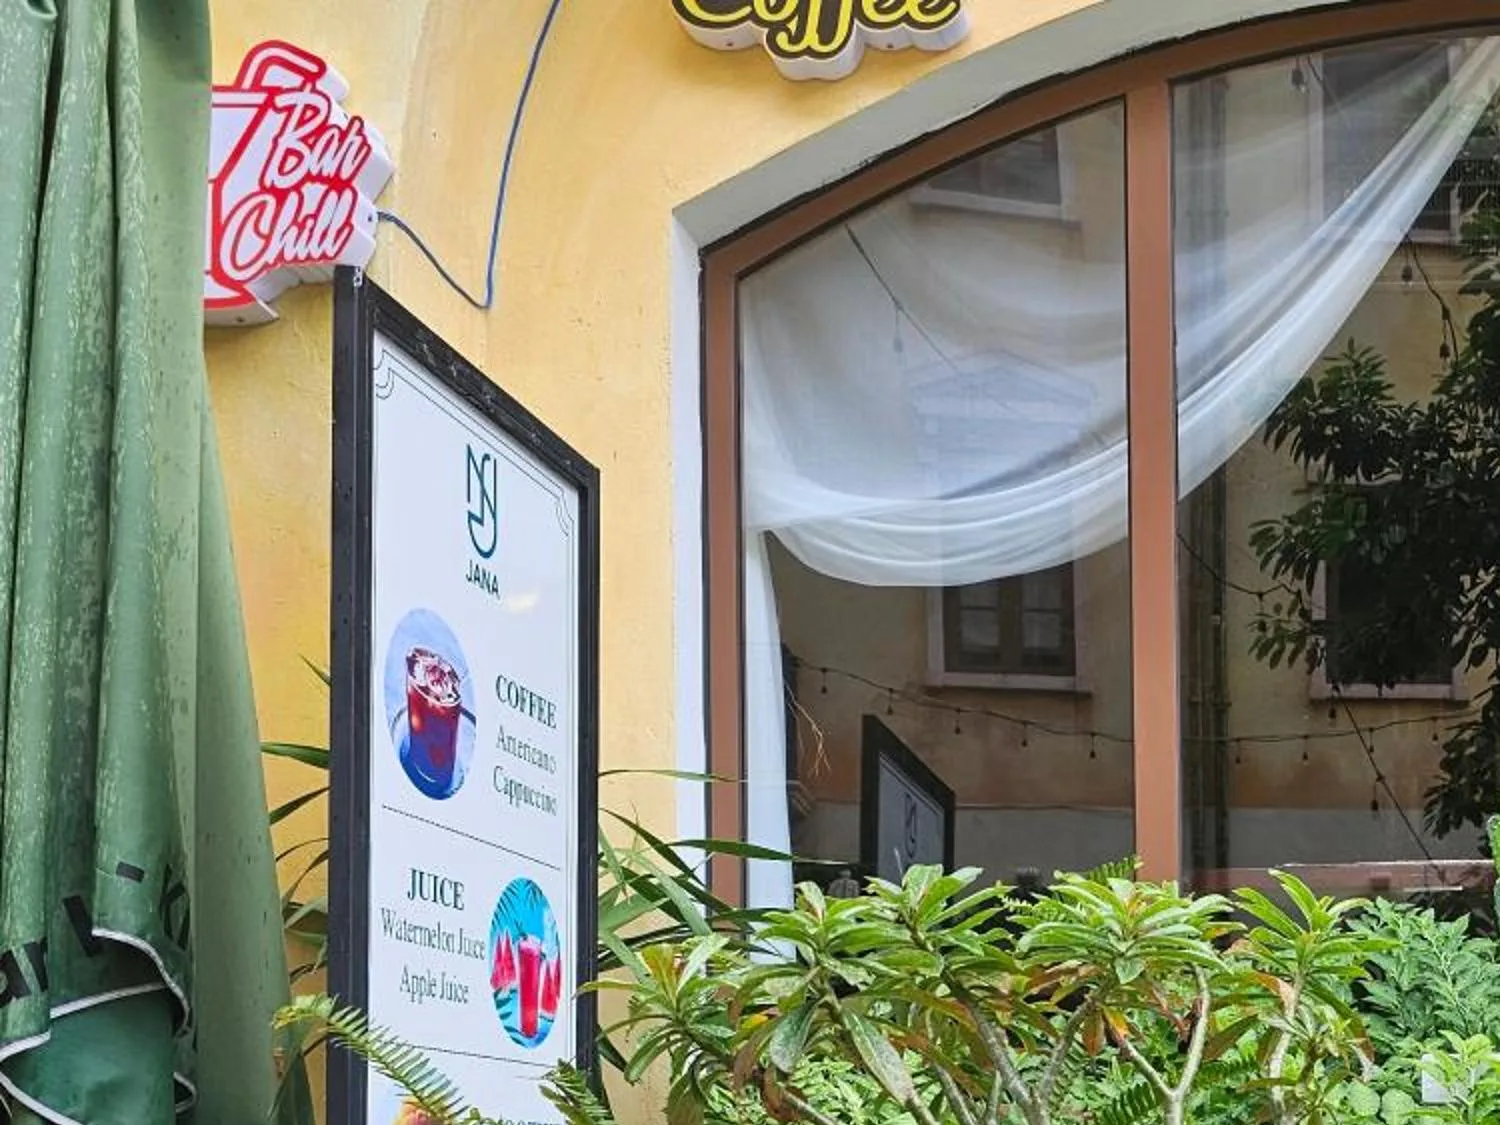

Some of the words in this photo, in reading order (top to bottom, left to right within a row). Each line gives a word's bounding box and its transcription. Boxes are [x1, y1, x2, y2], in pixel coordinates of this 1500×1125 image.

[220, 186, 360, 283] Chill
[466, 559, 500, 598] JANA
[495, 674, 557, 729] COFFEE
[496, 725, 557, 775] Americano
[493, 765, 557, 816] Cappuccino
[407, 867, 465, 911] JUICE
[380, 907, 455, 955] Watermelon
[457, 927, 486, 961] Juice
[399, 964, 437, 1005] Apple
[439, 971, 469, 1004] Juice
